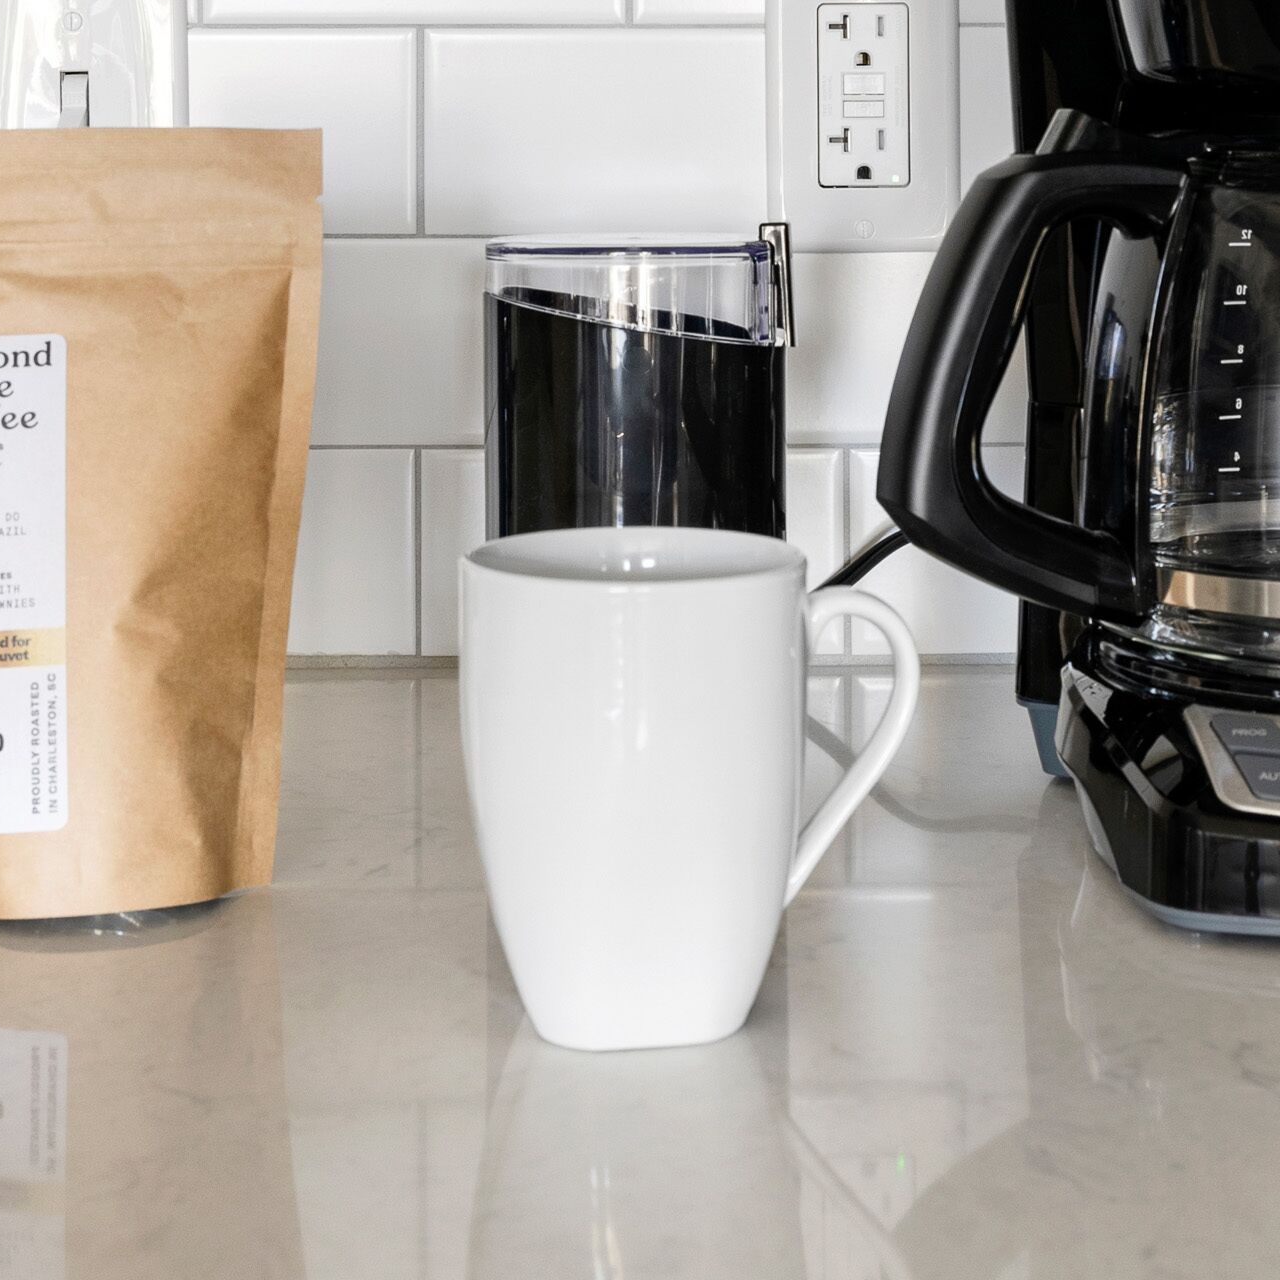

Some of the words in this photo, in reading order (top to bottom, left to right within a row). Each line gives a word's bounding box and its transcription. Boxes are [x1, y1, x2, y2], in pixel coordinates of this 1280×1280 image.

[11, 635, 31, 647] for
[30, 682, 40, 746] ROASTED
[1231, 728, 1267, 737] PROG
[31, 752, 40, 814] PROUDLY
